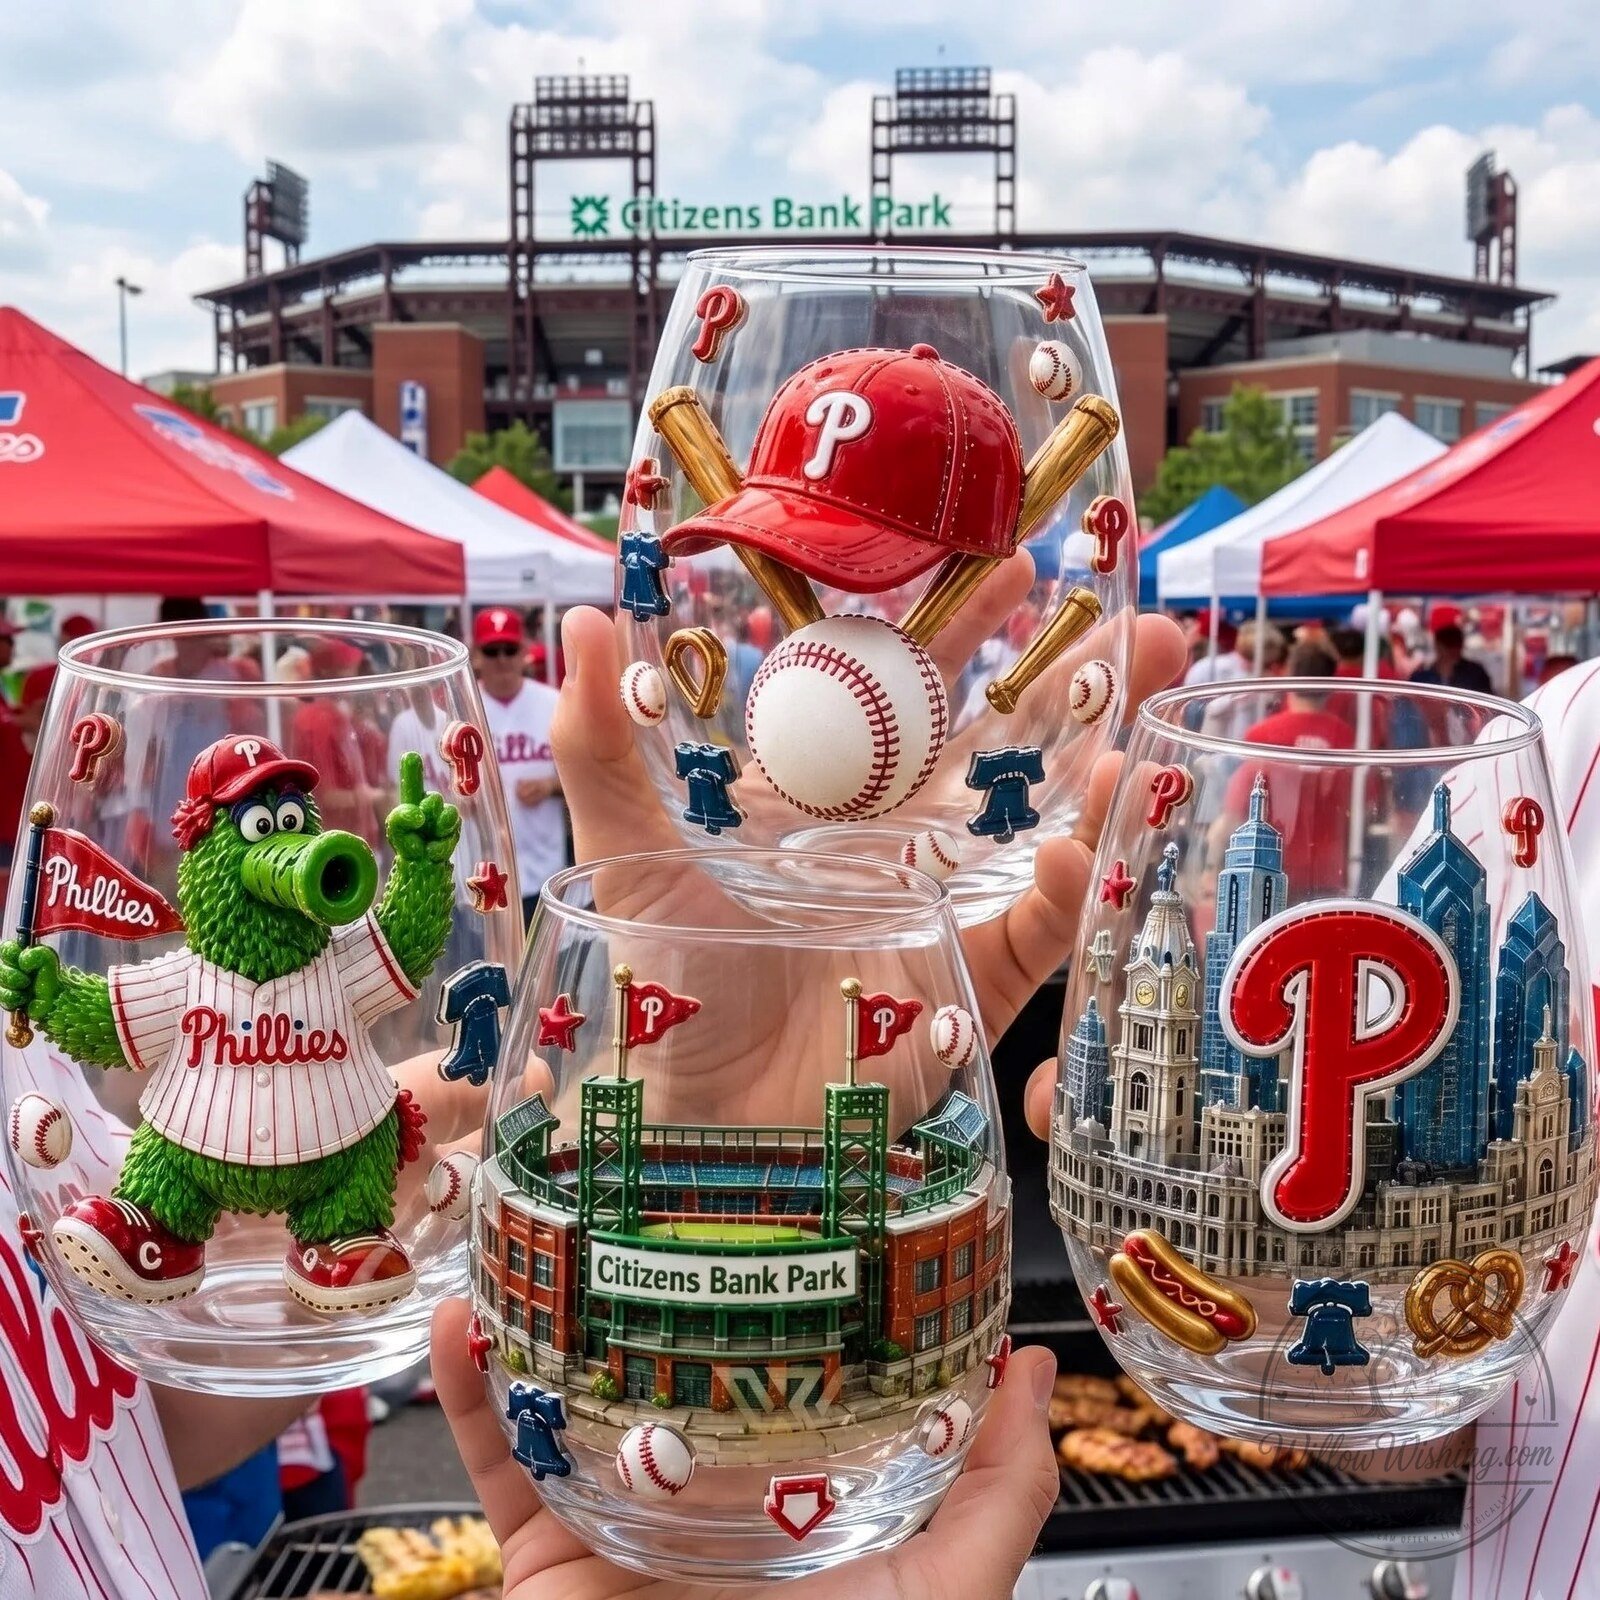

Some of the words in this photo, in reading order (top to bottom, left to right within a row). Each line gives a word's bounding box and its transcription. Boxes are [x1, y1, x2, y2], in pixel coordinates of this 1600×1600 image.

[620, 199, 760, 230] Citizens
[772, 194, 863, 229] Bank
[874, 194, 952, 228] Park
[691, 284, 746, 364] P
[804, 390, 873, 481] P
[69, 713, 118, 784] P
[234, 740, 261, 767] P
[1146, 763, 1194, 830] P
[45, 855, 156, 928] Phillies
[181, 1004, 349, 1069] Phillies
[640, 996, 664, 1034] P
[873, 1007, 896, 1045] P
[1218, 898, 1462, 1234] P
[138, 1241, 163, 1270] C
[598, 1254, 701, 1294] Citizens
[710, 1264, 780, 1295] Bank
[787, 1260, 848, 1294] Park
